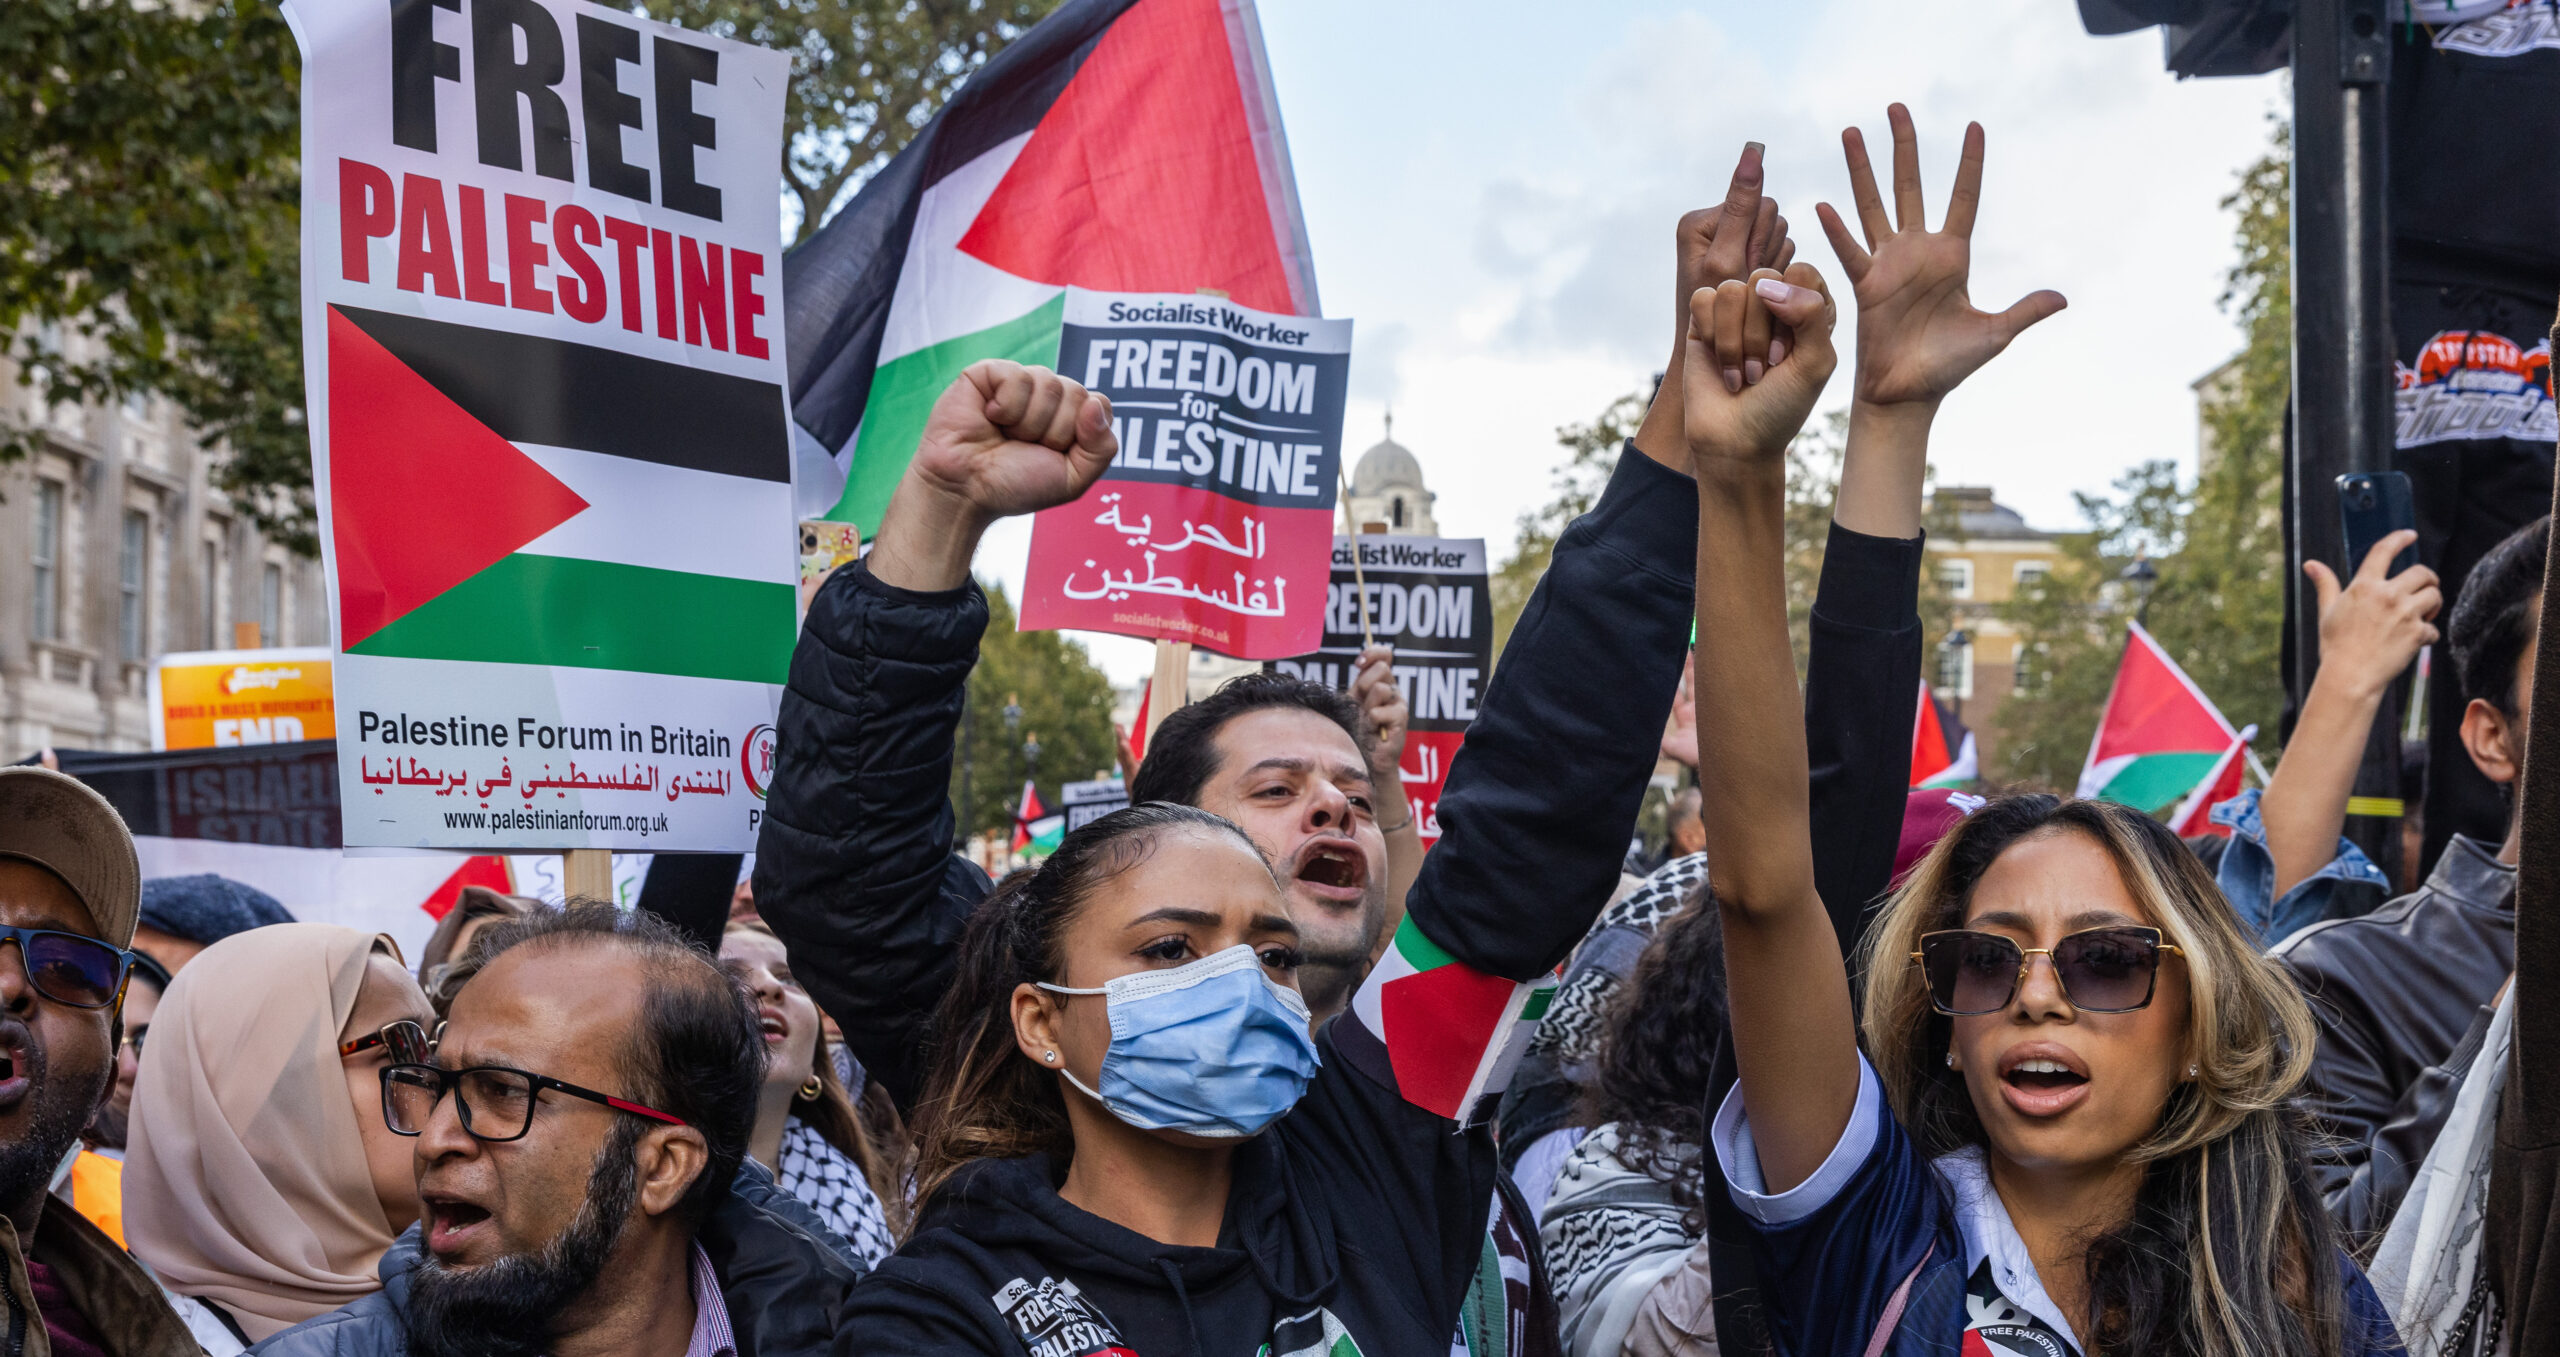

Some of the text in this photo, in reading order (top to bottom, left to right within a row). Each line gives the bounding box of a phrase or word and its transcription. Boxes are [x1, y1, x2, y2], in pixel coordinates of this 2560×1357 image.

[389, 0, 723, 222] FREE
[339, 157, 770, 360] PALESTINE
[1108, 302, 1310, 346] Socialist Worker
[1084, 339, 1317, 415] FREEDOM
[1180, 391, 1220, 421] for
[1095, 492, 1265, 560] الحرية
[1332, 543, 1467, 568] cialist Worker
[1063, 550, 1286, 617] لفلسطين
[1325, 582, 1474, 639] REEDOM
[359, 711, 731, 758] Palestine Forum in Britain
[361, 755, 731, 809] المنتدى الفلسطيني في بريطانيا
[444, 808, 669, 837] www.palestinianforum.org.uk
[1980, 1326, 2061, 1357] FREE PALESTIN
